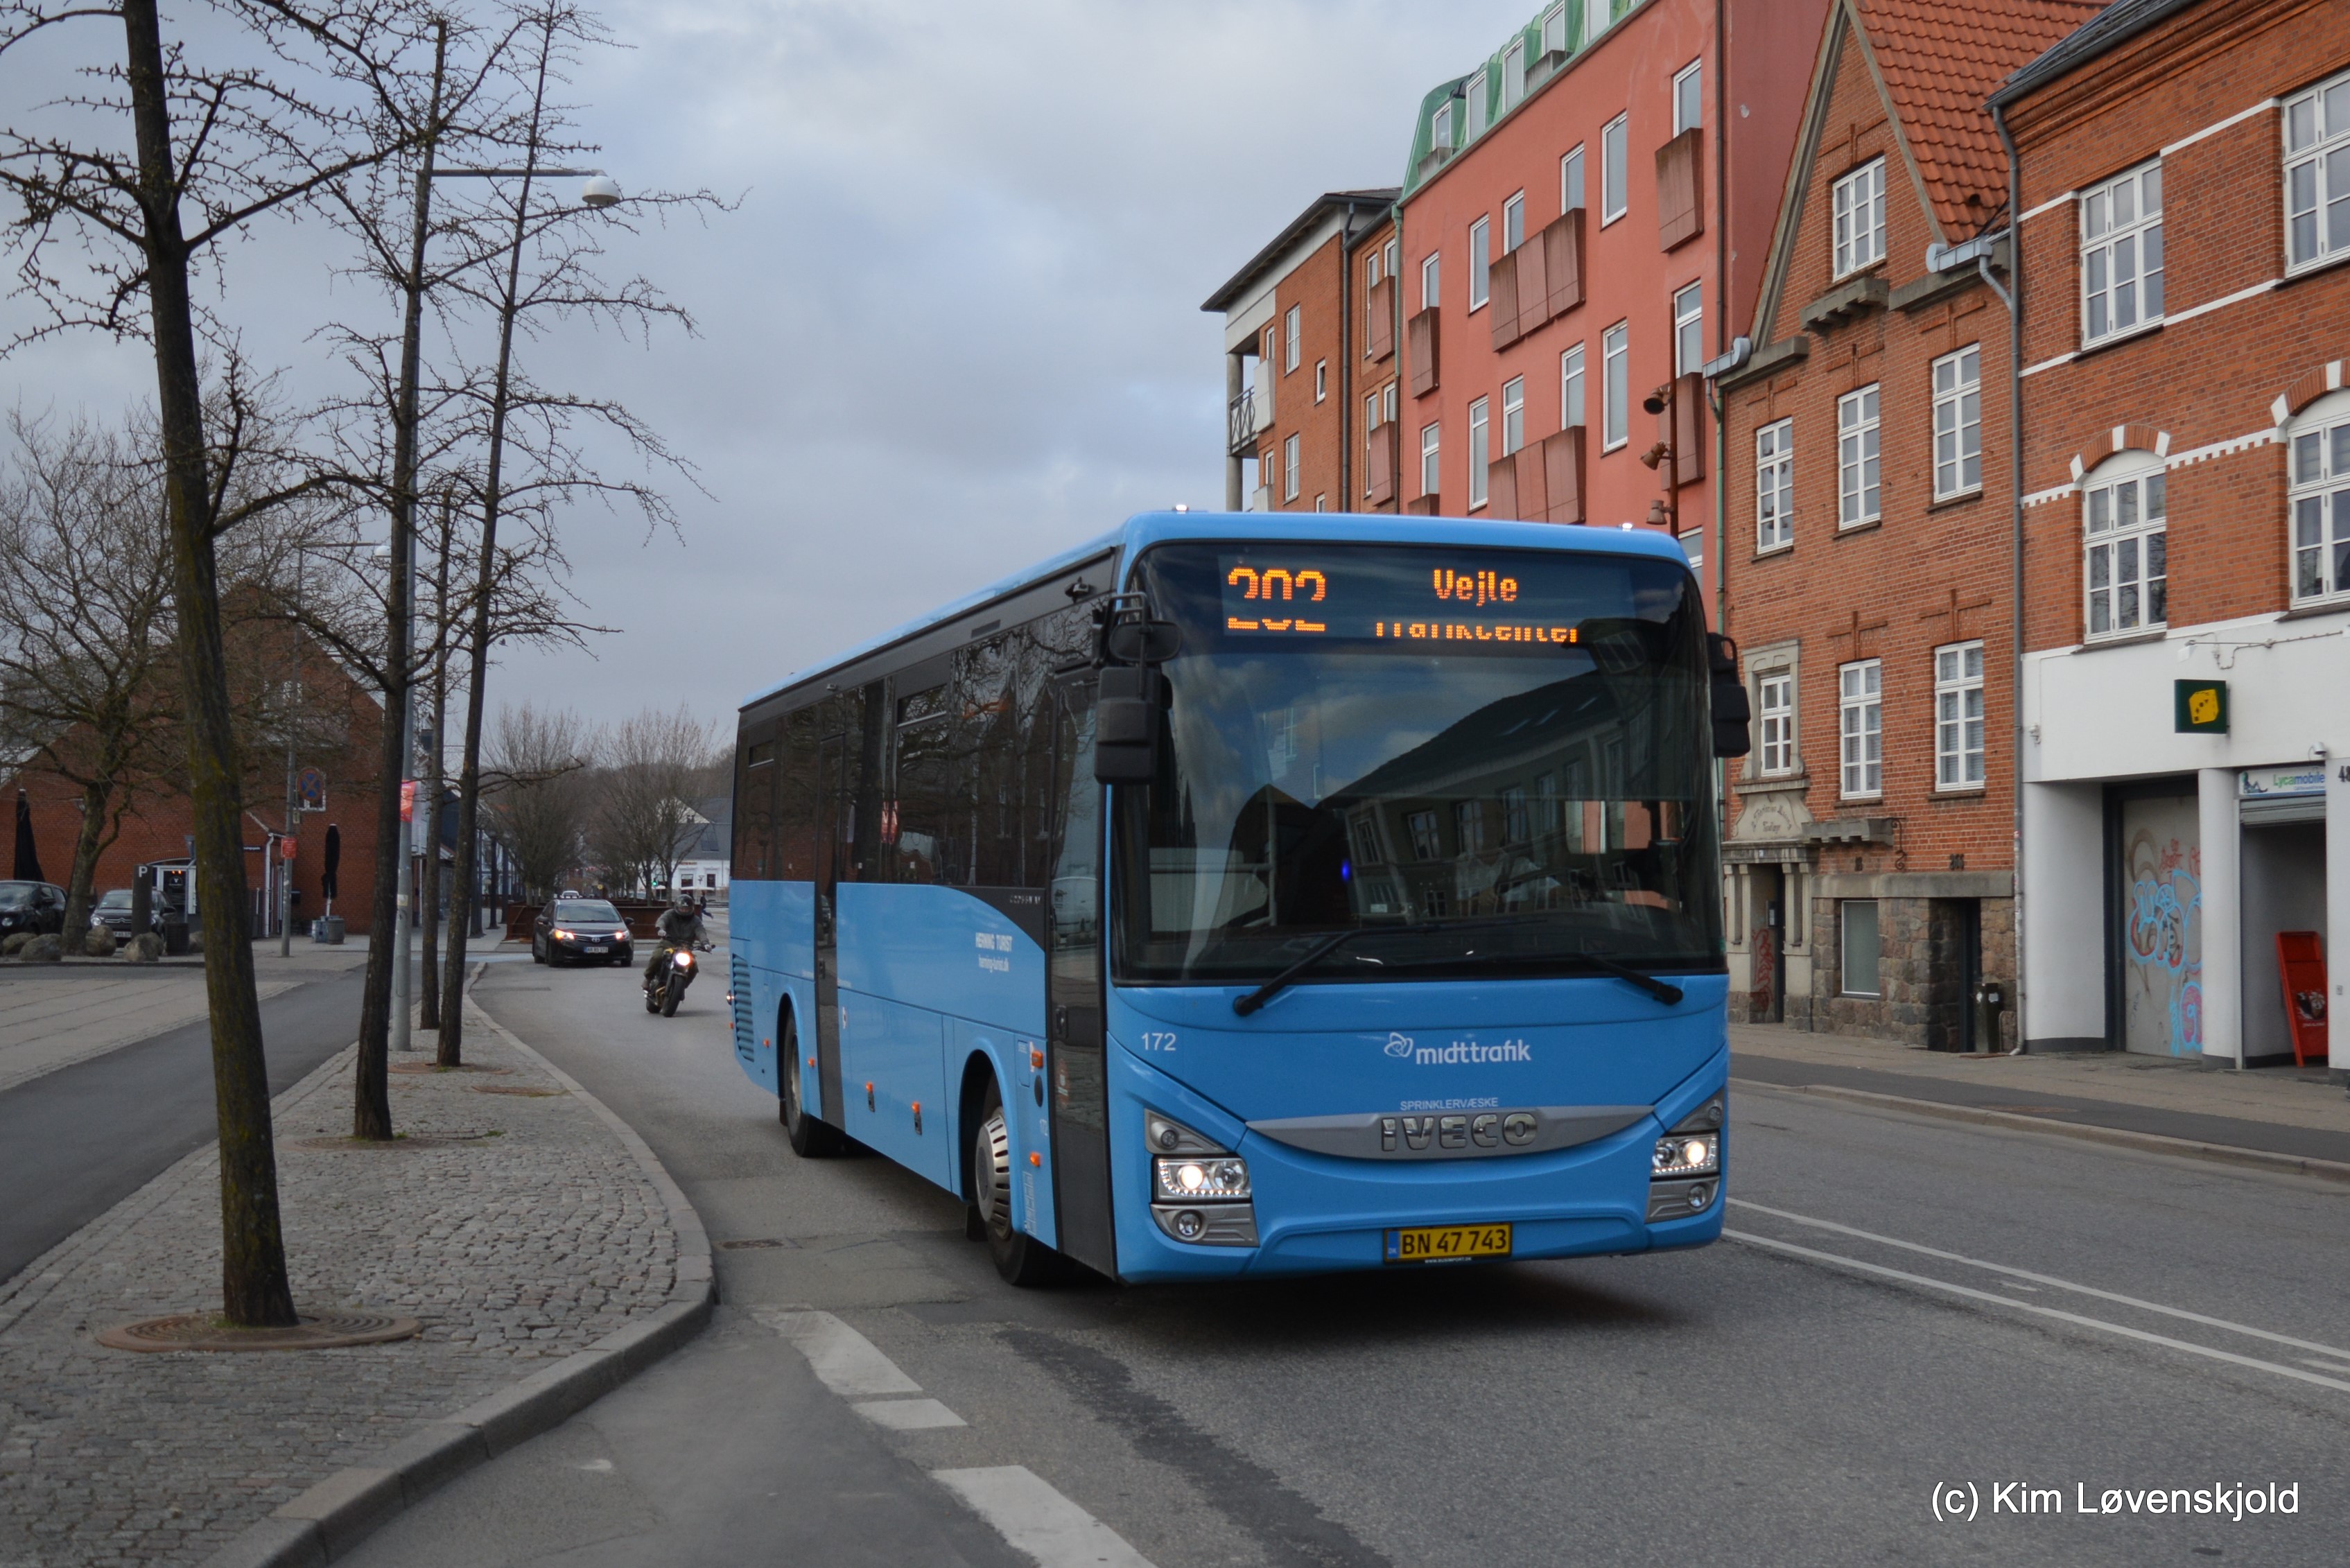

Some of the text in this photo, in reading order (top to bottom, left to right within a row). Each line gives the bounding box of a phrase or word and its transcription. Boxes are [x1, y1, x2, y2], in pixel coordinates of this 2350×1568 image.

[1228, 568, 1517, 631] 202 Vejle
[2273, 771, 2325, 788] Lycamobile
[139, 866, 148, 878] P
[1141, 1032, 1176, 1051] 172
[1416, 1039, 1531, 1065] midttrafik
[1400, 1097, 1499, 1111] SPRINKLERVÆSKE
[1382, 1112, 1538, 1151] IVECO
[1402, 1233, 1431, 1255] BN
[1436, 1231, 1463, 1253] 47
[1468, 1228, 1506, 1251] 743
